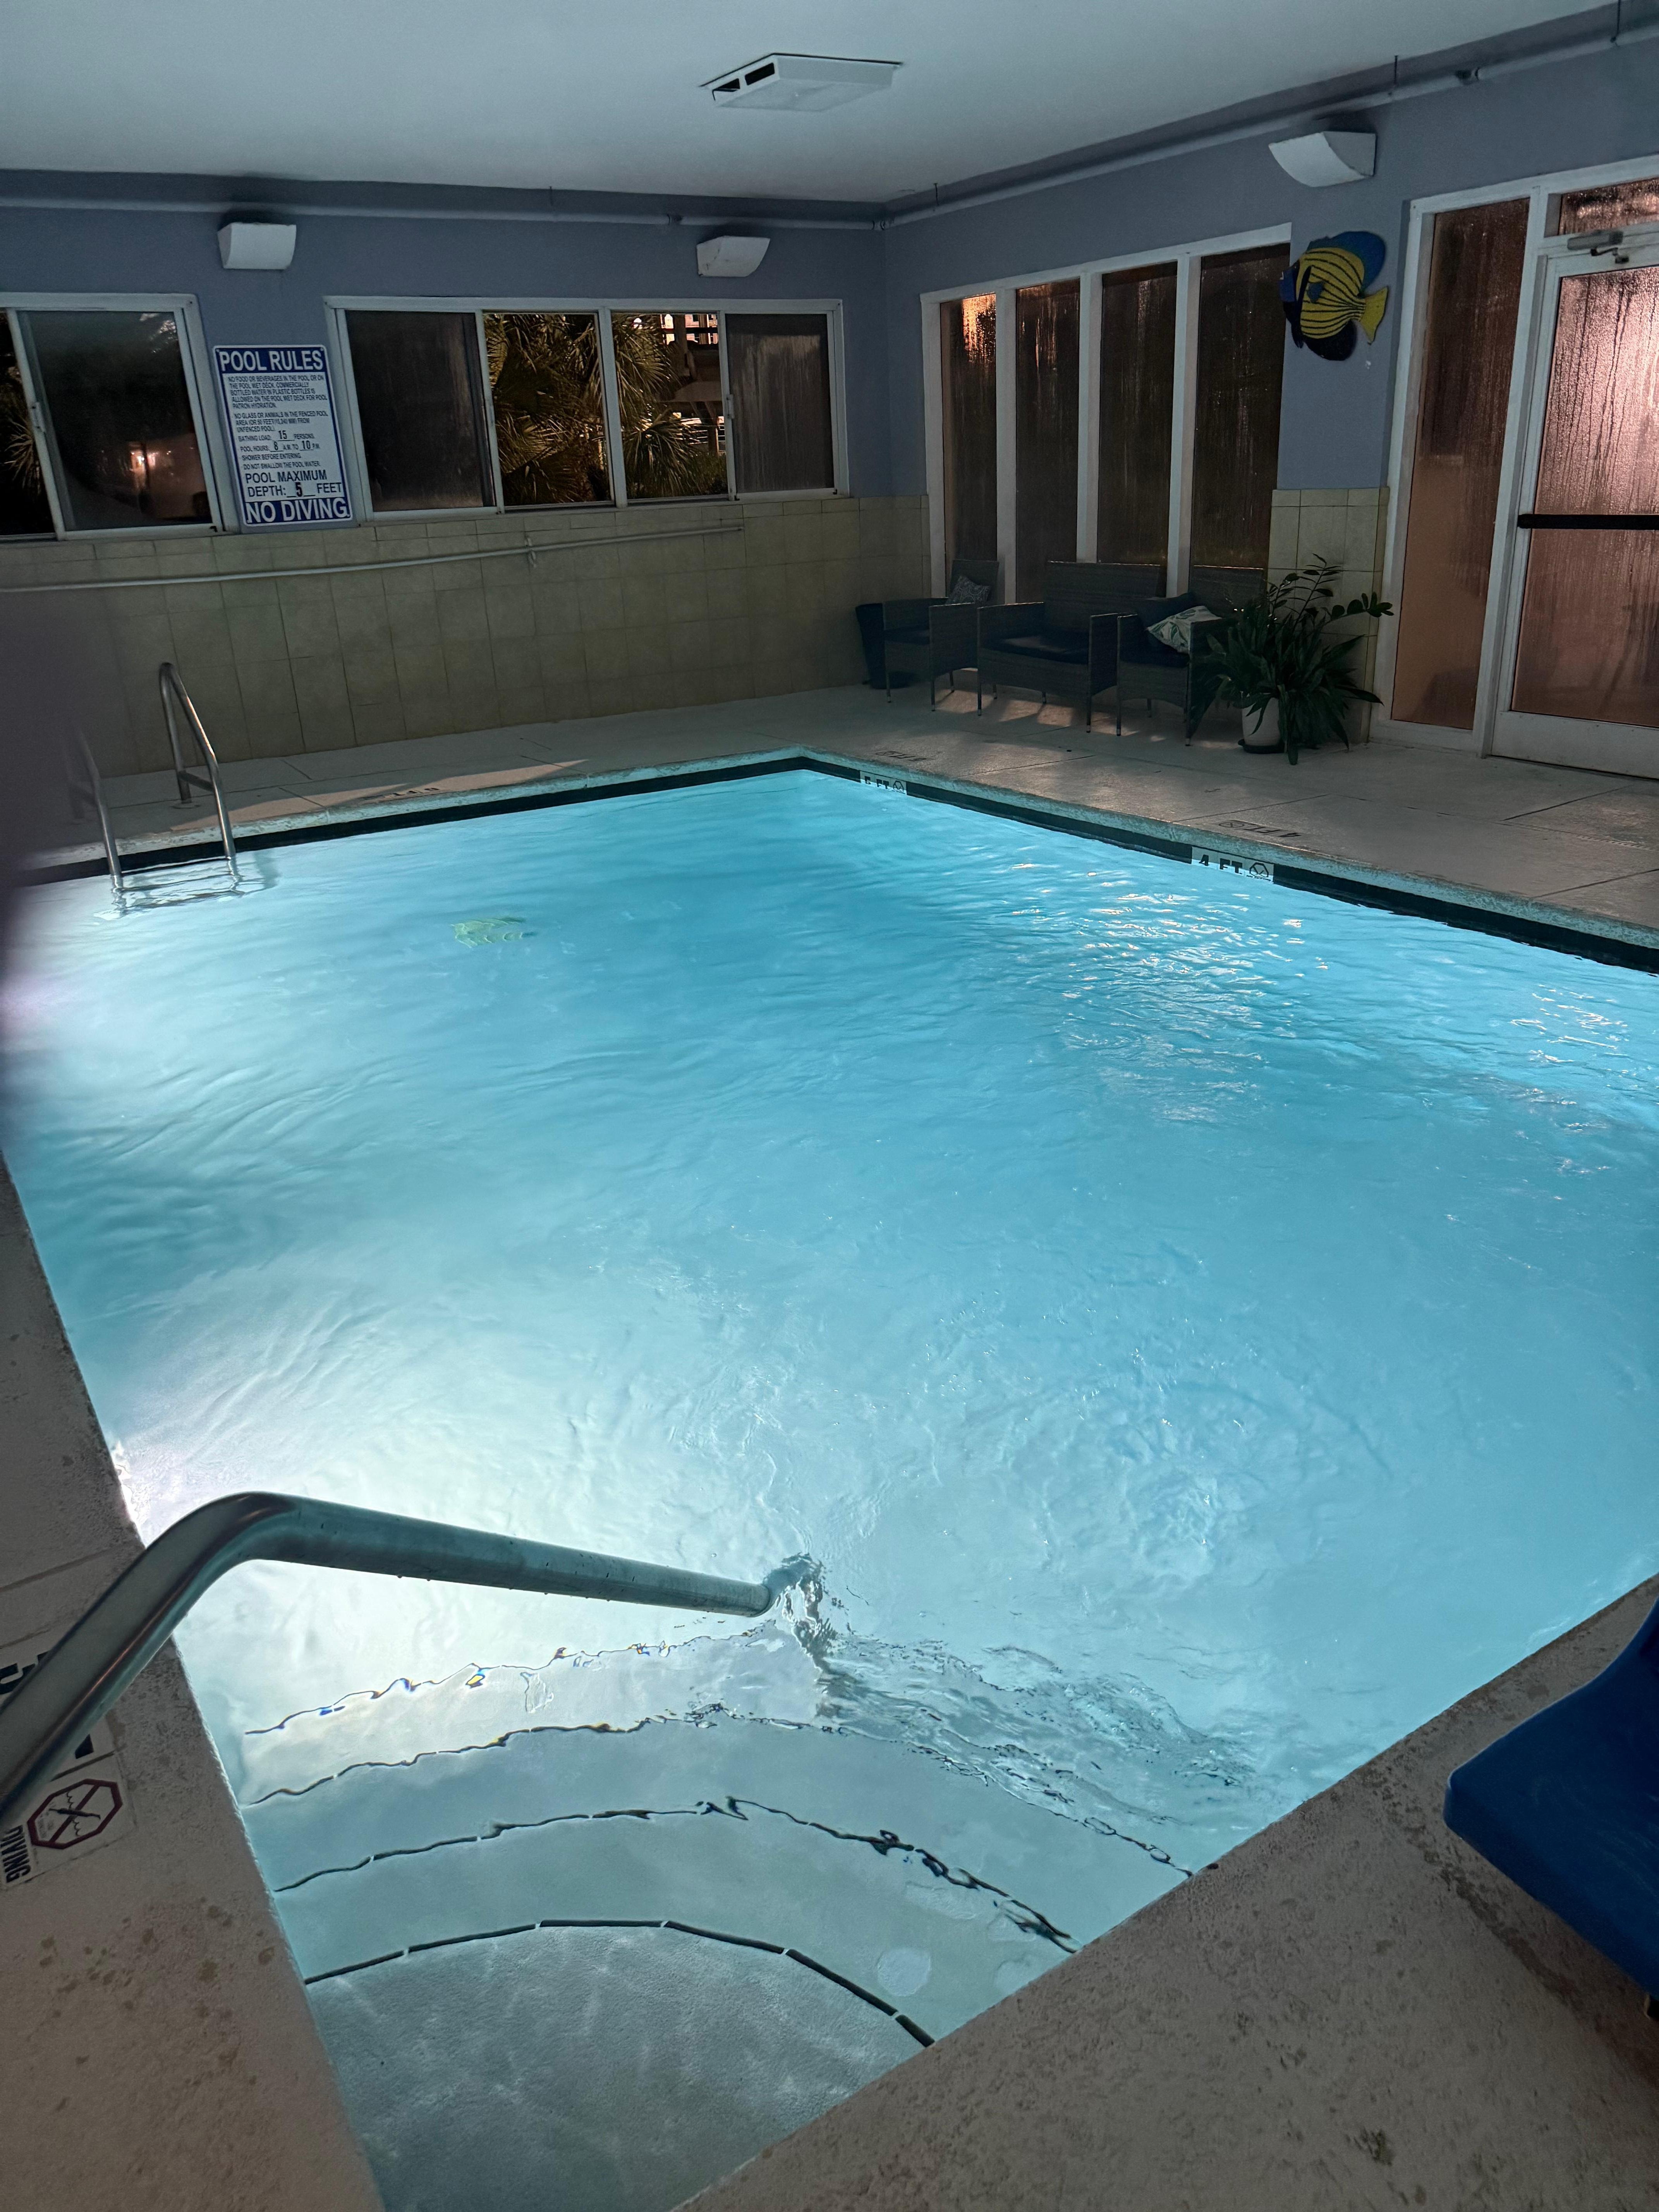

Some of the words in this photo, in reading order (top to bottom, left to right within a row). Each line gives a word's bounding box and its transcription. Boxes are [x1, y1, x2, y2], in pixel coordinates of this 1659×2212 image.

[219, 350, 267, 371] POOL
[268, 350, 324, 370] RULES
[278, 430, 287, 439] 15
[274, 441, 278, 450] 8
[302, 440, 311, 449] 10
[246, 472, 275, 483] POOL
[278, 469, 327, 482] MAXIMUM
[248, 485, 286, 497] DEPTH:
[295, 482, 302, 497] 5
[317, 482, 342, 493] FEET
[246, 501, 276, 523] NO
[281, 497, 347, 521] DIVING
[1199, 854, 1209, 866] 4
[0, 1825, 31, 1883] DIVING
